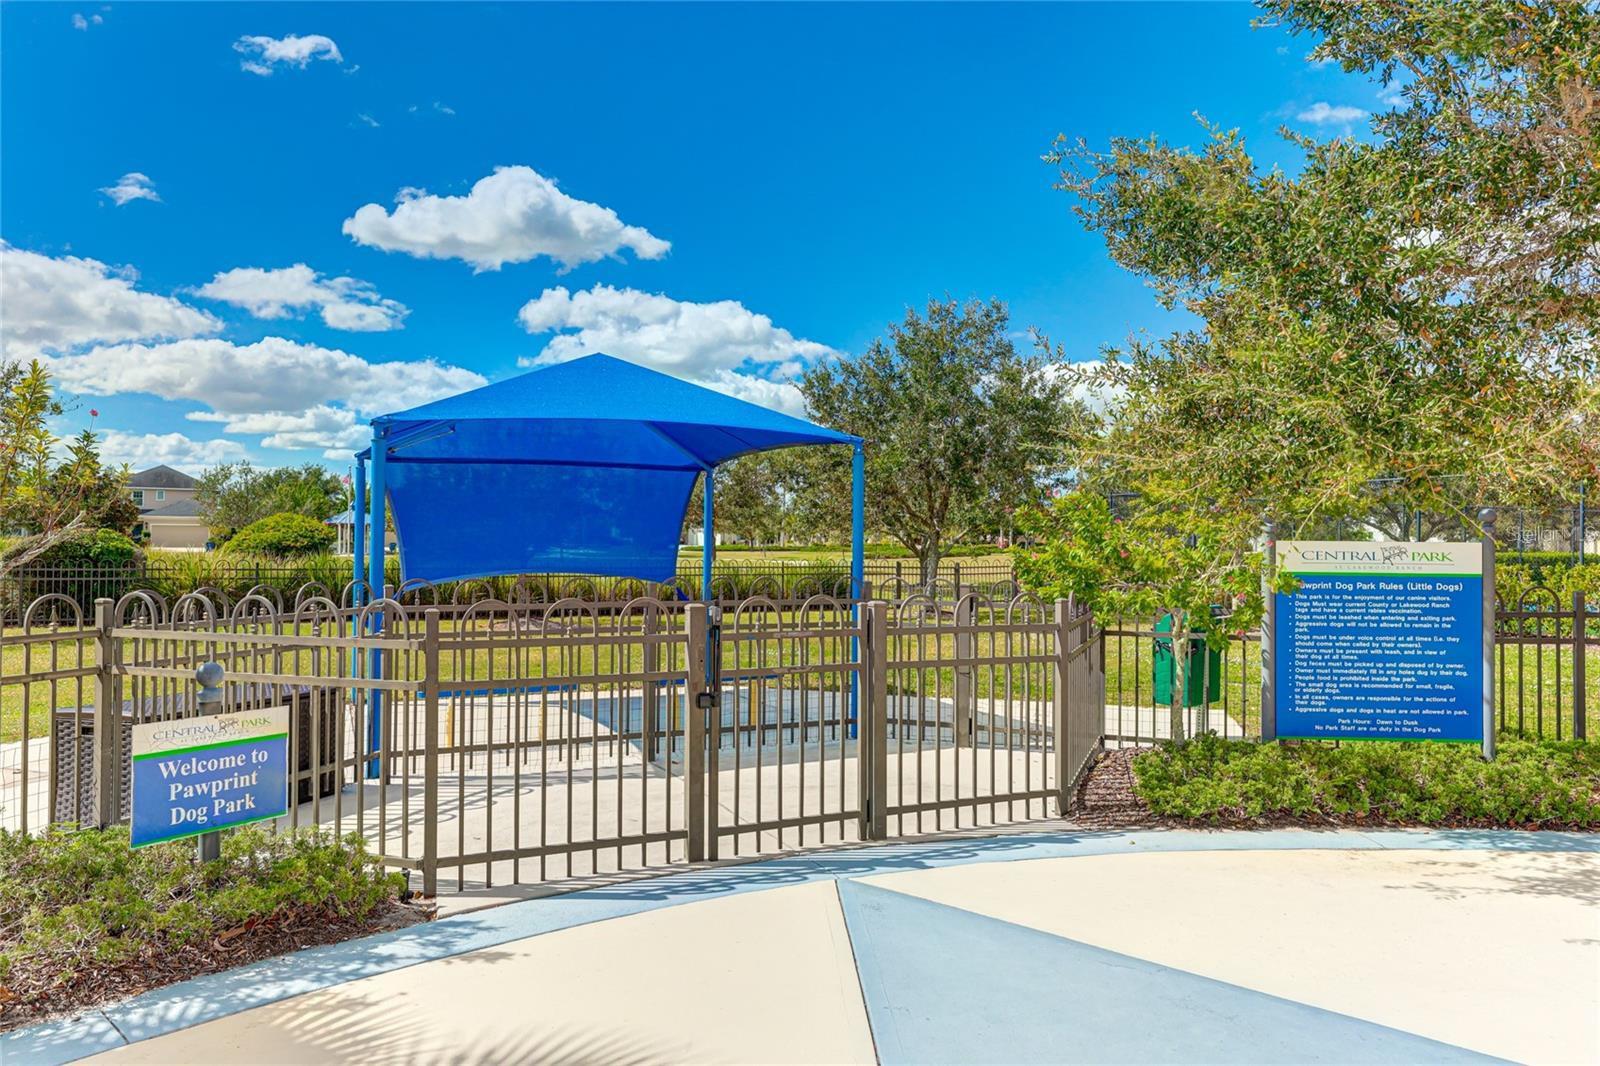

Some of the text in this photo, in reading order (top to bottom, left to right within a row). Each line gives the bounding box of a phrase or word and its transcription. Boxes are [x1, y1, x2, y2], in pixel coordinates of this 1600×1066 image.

[1301, 551, 1453, 562] CENTRAL PARK
[1299, 581, 1463, 593] awprint Dog Park Rules (Little Dogs)
[1380, 614, 1406, 622] entering
[1294, 633, 1310, 641] Dogs
[1325, 681, 1337, 689] dog
[152, 725, 218, 740] CENTRAL
[241, 717, 271, 728] PARK
[158, 749, 268, 779] Welcome to
[168, 770, 258, 801] Pawprint
[169, 793, 256, 826] Dog Park
